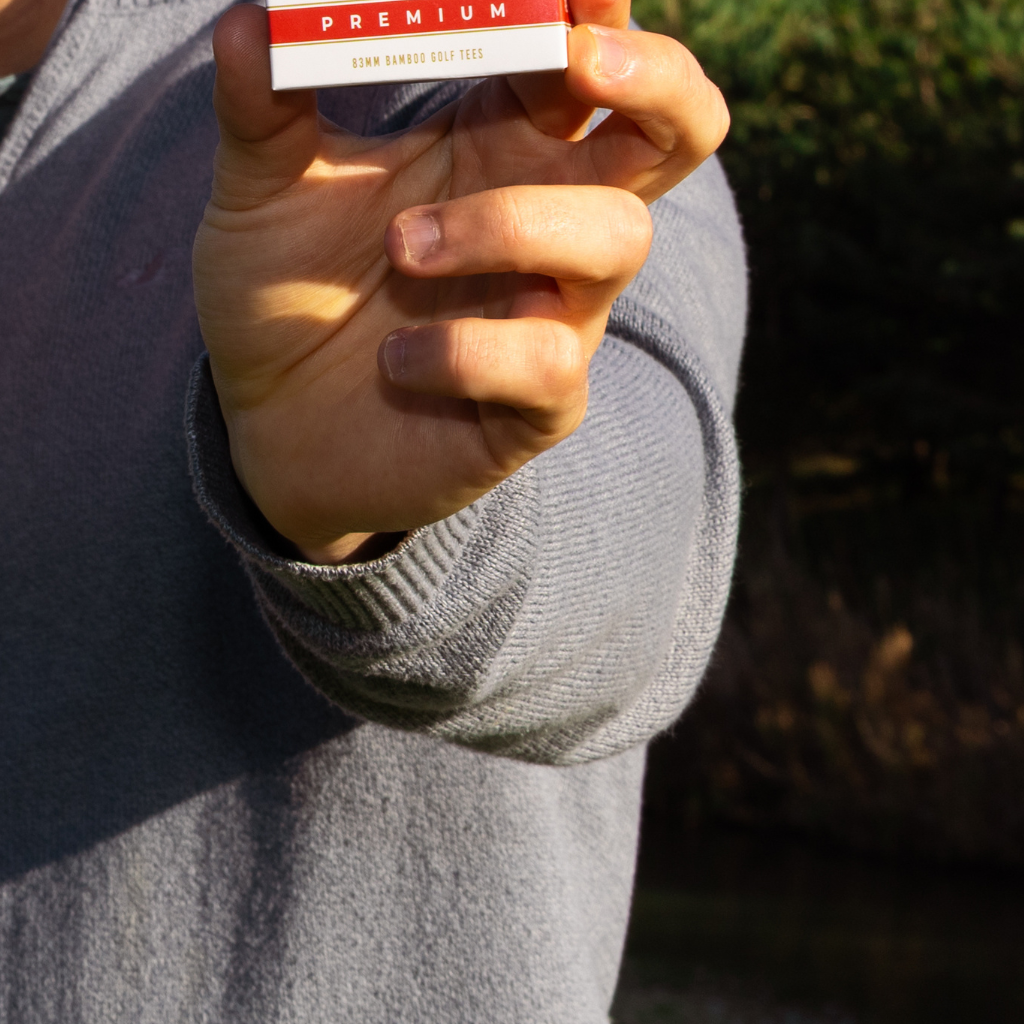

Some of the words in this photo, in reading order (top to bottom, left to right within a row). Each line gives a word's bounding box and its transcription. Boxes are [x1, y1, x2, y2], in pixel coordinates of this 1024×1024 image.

[321, 3, 506, 32] PREMIUM
[352, 56, 380, 69] 83MM
[385, 52, 426, 67] BAMBOO
[431, 50, 455, 63] GOLF
[459, 48, 484, 61] TEES
